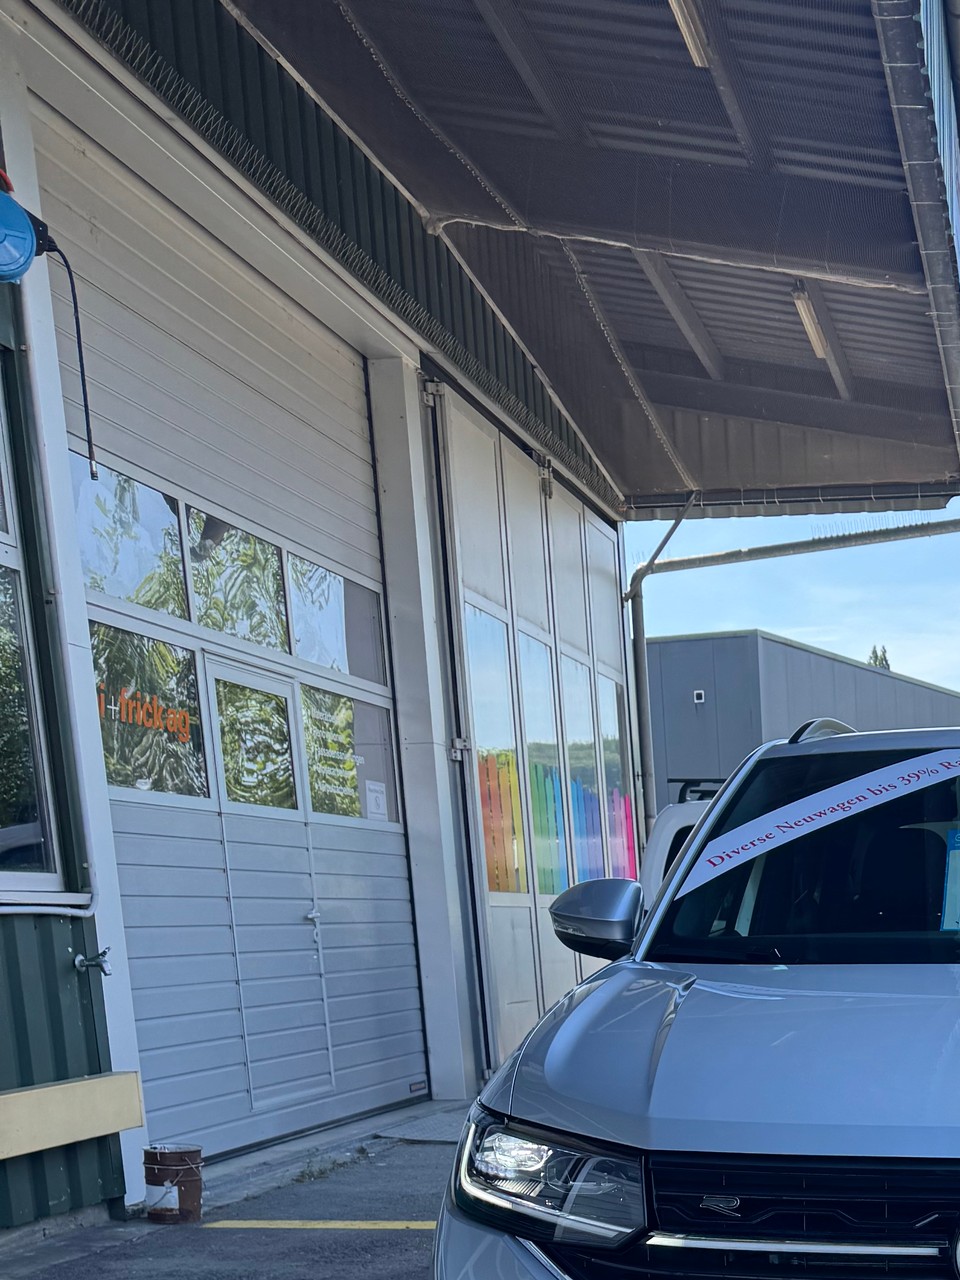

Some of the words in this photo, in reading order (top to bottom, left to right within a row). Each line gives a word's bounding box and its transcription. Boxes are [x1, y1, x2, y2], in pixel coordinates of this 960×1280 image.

[705, 829, 776, 868] Diverse
[774, 794, 868, 834] Neuwagen
[866, 783, 898, 798] bis
[897, 767, 940, 787] 39%
